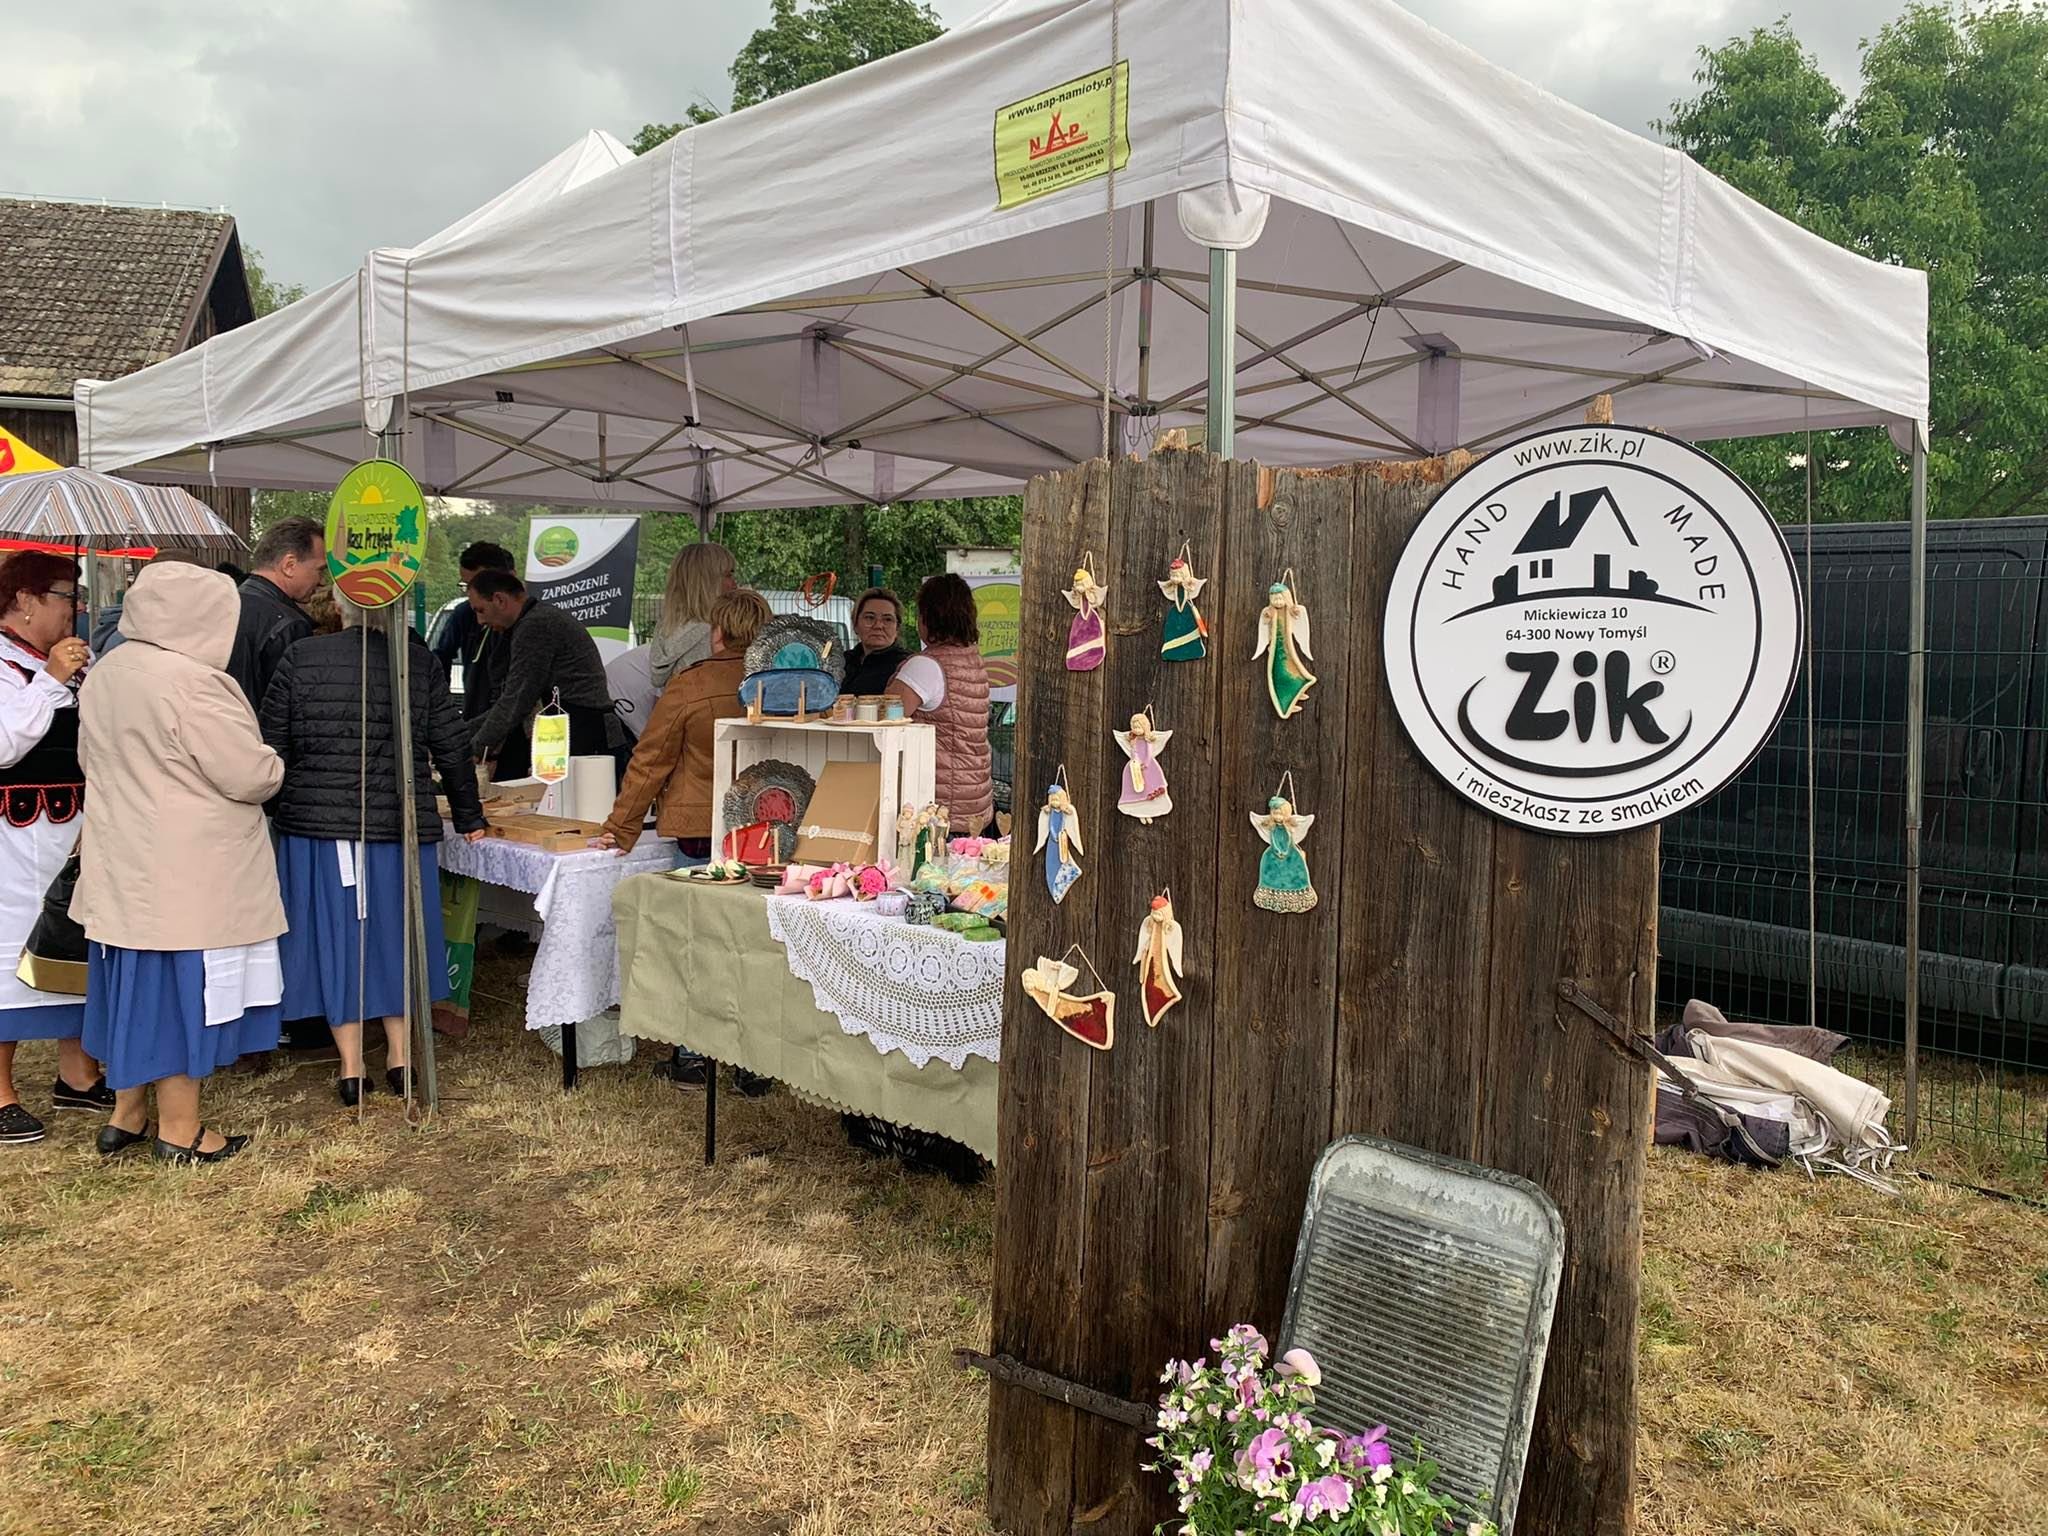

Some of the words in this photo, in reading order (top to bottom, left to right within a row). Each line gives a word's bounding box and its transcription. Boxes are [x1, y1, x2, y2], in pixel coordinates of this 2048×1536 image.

[1008, 76, 1112, 120] www.nap-namioty.p
[1513, 432, 1645, 466] www.zik.pl
[1442, 503, 1507, 590] HAND
[1663, 504, 1726, 601] MADE
[541, 573, 610, 600] ZAPROSZENIE
[552, 587, 622, 609] OWARZYSZENIA
[1524, 608, 1606, 621] Mickiewicza
[1611, 607, 1628, 619] 10
[1505, 629, 1550, 641] 64-300
[1555, 629, 1595, 642] Nowy
[1599, 626, 1647, 641] Tomyśl
[1505, 650, 1670, 744] Zik
[1457, 767, 1468, 781] i
[1466, 777, 1570, 824] mieszkasz
[1579, 809, 1604, 824] ze
[1611, 778, 1704, 822] smakiem
